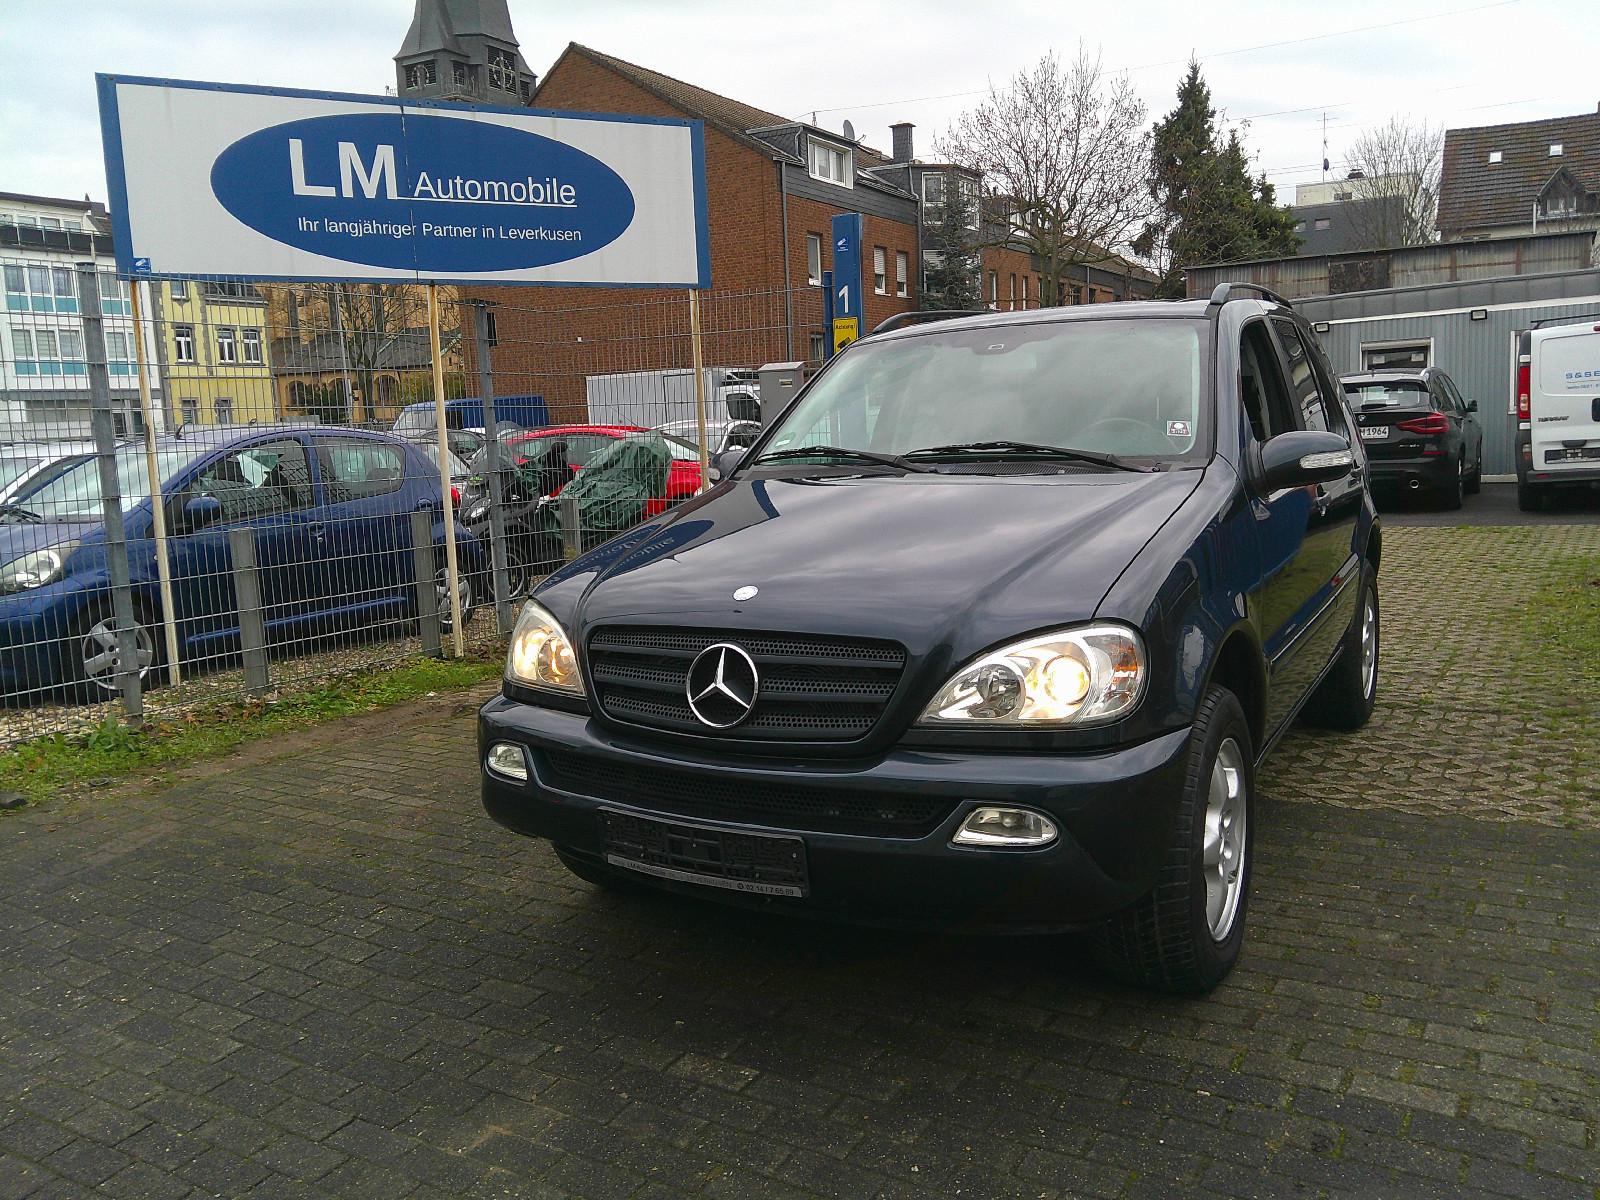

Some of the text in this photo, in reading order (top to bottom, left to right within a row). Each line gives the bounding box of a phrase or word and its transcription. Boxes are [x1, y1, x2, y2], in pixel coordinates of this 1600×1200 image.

[289, 138, 576, 204] LM Automobile
[298, 216, 582, 241] Ihr langjähriger Partner in Leverkusen
[838, 285, 849, 314] 1
[1367, 427, 1388, 436] 1964
